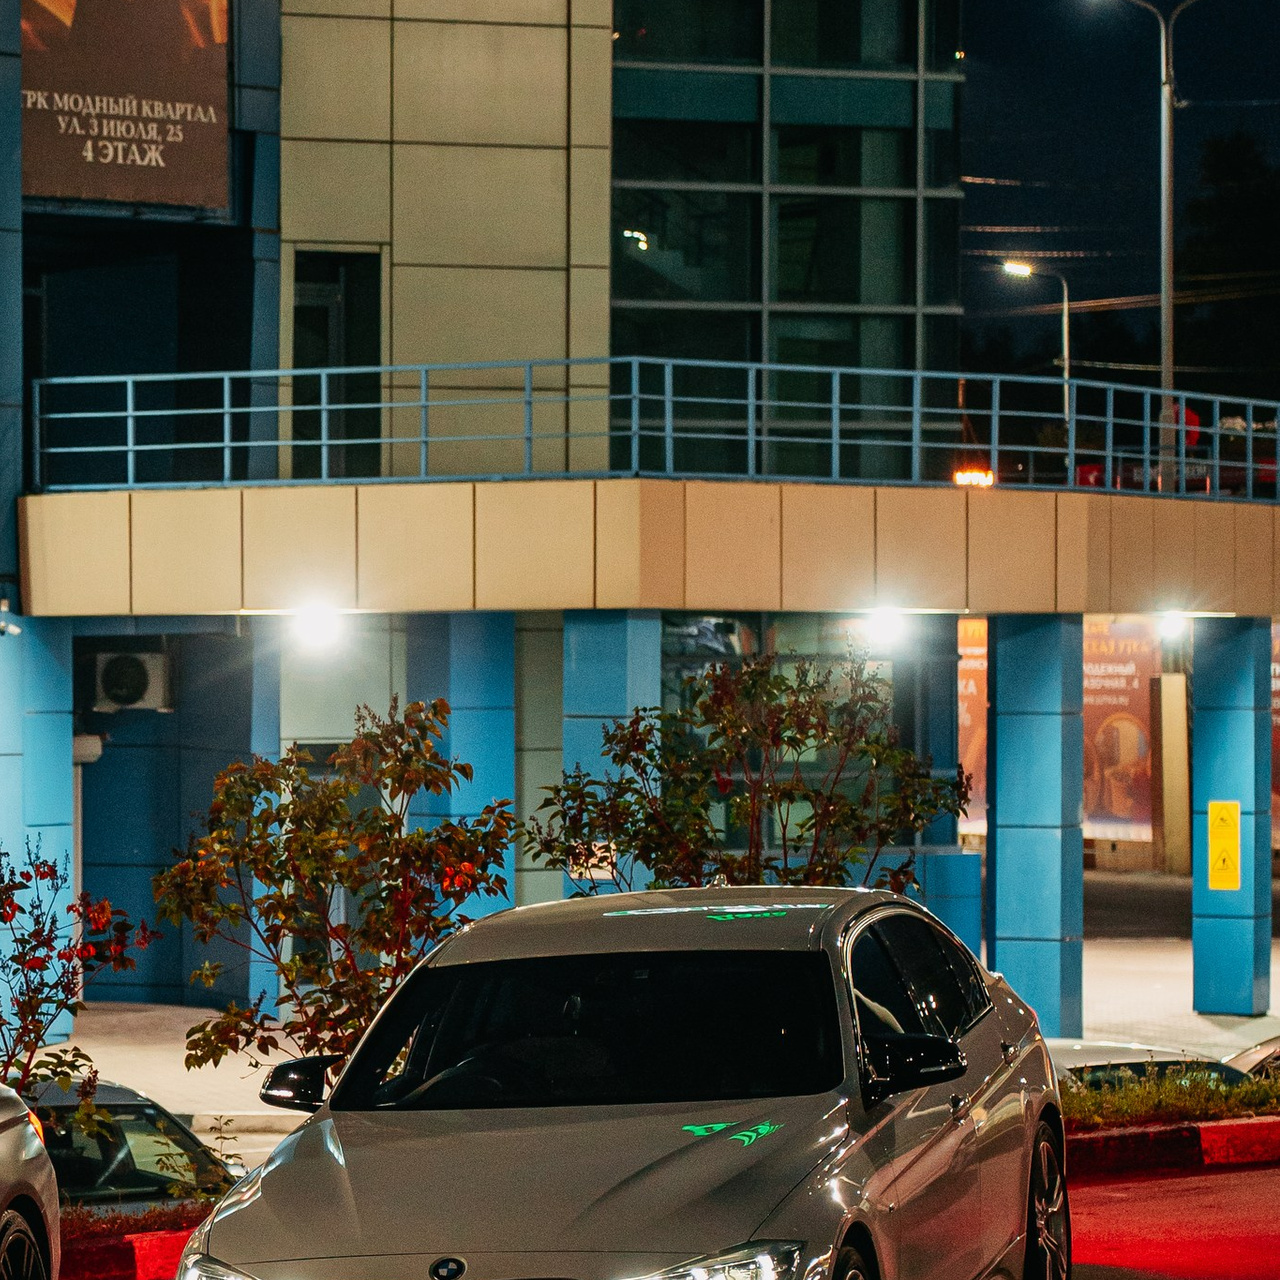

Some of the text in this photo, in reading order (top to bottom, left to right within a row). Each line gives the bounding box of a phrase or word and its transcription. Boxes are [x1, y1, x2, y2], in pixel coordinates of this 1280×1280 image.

[53, 92, 138, 117] МОДНЫЙ
[141, 99, 218, 124] КВАРТАЛ
[90, 117, 99, 137] 3
[166, 124, 184, 143] 25
[82, 140, 165, 167] 4 ЭТАЖ
